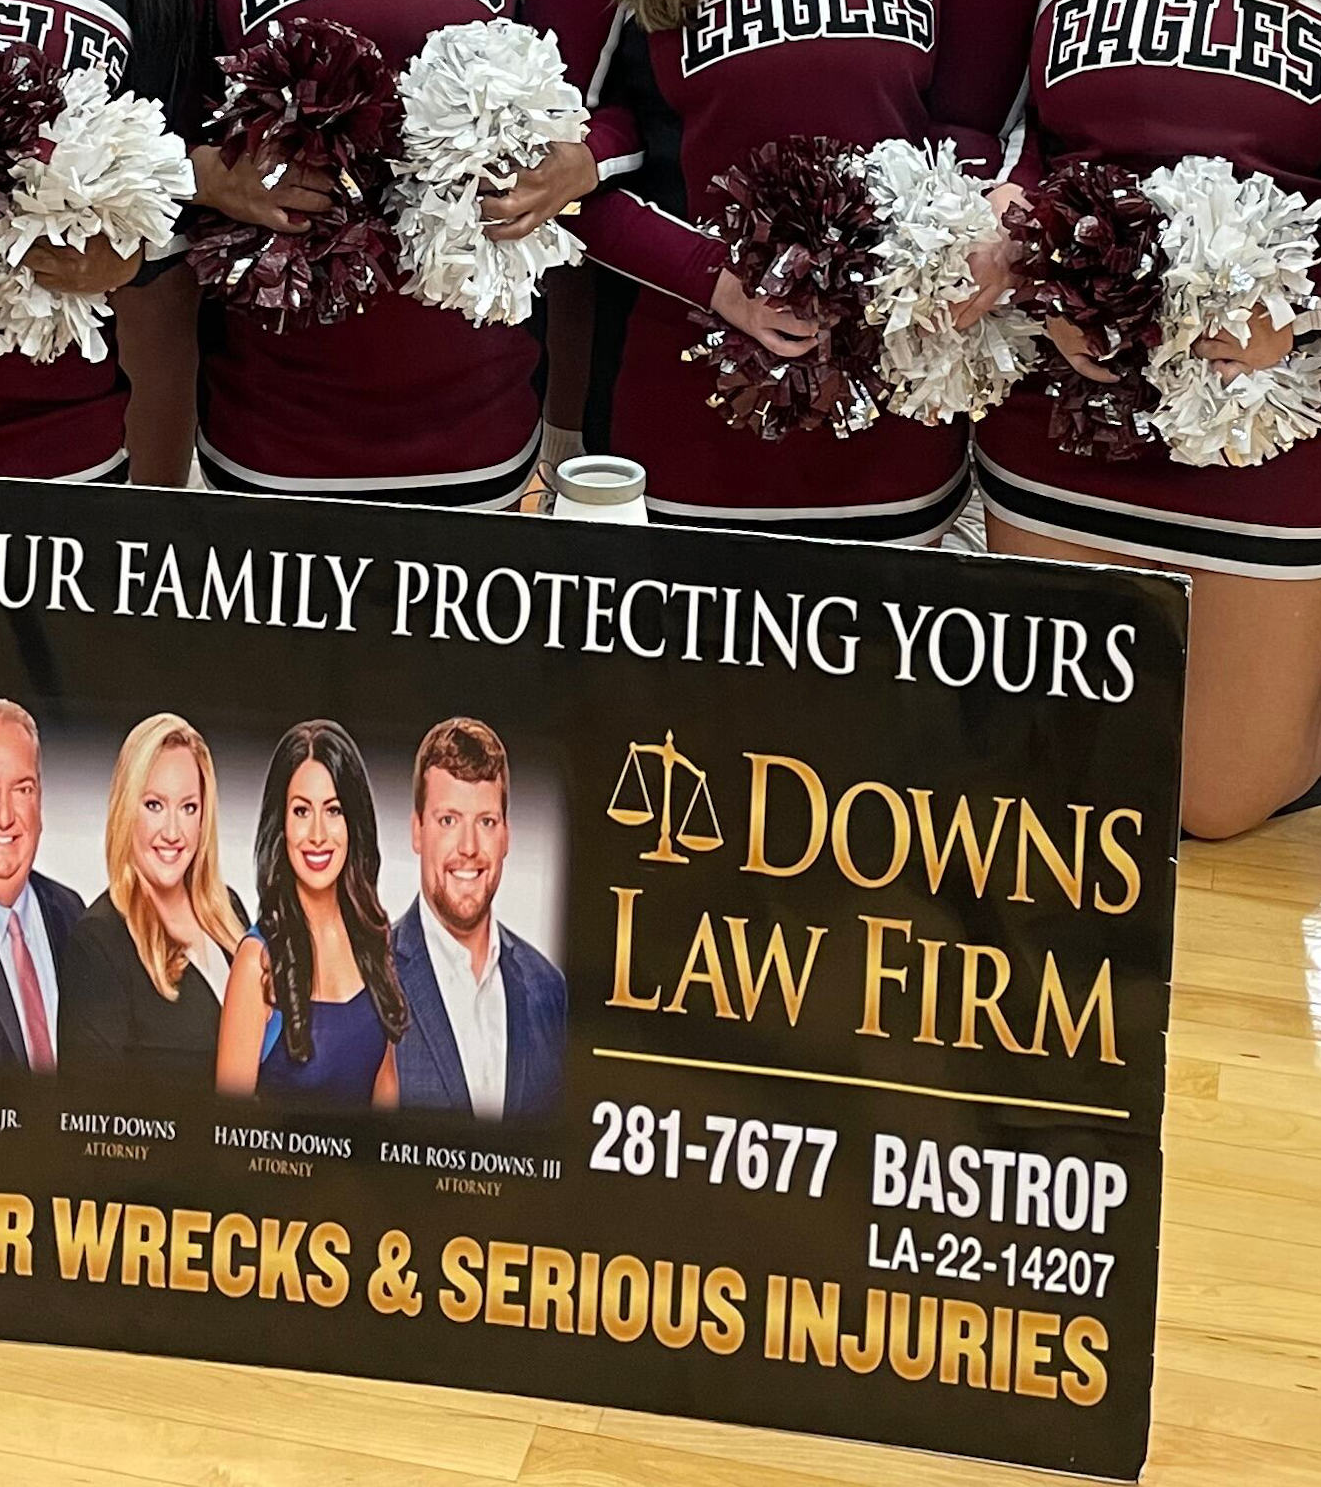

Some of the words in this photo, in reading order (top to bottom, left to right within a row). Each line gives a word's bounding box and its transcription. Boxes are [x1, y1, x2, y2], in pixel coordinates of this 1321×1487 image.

[113, 539, 374, 633] FAMILY
[391, 559, 861, 677] PROTECTING
[882, 601, 1137, 704] YOURS
[739, 751, 1143, 915] DOWNS
[605, 886, 829, 1028] LAW
[855, 914, 1126, 1066] FIRM
[0, 1109, 22, 1132] JR.
[60, 1112, 111, 1135] EMILY
[113, 1115, 176, 1141] DOWNS
[214, 1125, 284, 1152] HAYDEN
[289, 1132, 352, 1159] DOWNS
[588, 1099, 839, 1199] 281-7677
[84, 1141, 150, 1161] ATTORNEY
[248, 1157, 314, 1178] ATTORNEY
[380, 1142, 422, 1166] EARL
[426, 1147, 467, 1170] ROSS
[542, 1159, 562, 1180] III
[436, 1177, 503, 1197] ATTORNEY
[871, 1132, 1129, 1235] BASTROP
[866, 1222, 1116, 1299] LA-22-14207
[52, 1196, 351, 1308] WRECKS
[368, 1229, 423, 1317] &
[439, 1235, 747, 1356] SERIOUS
[764, 1273, 1110, 1408] INJURIES
